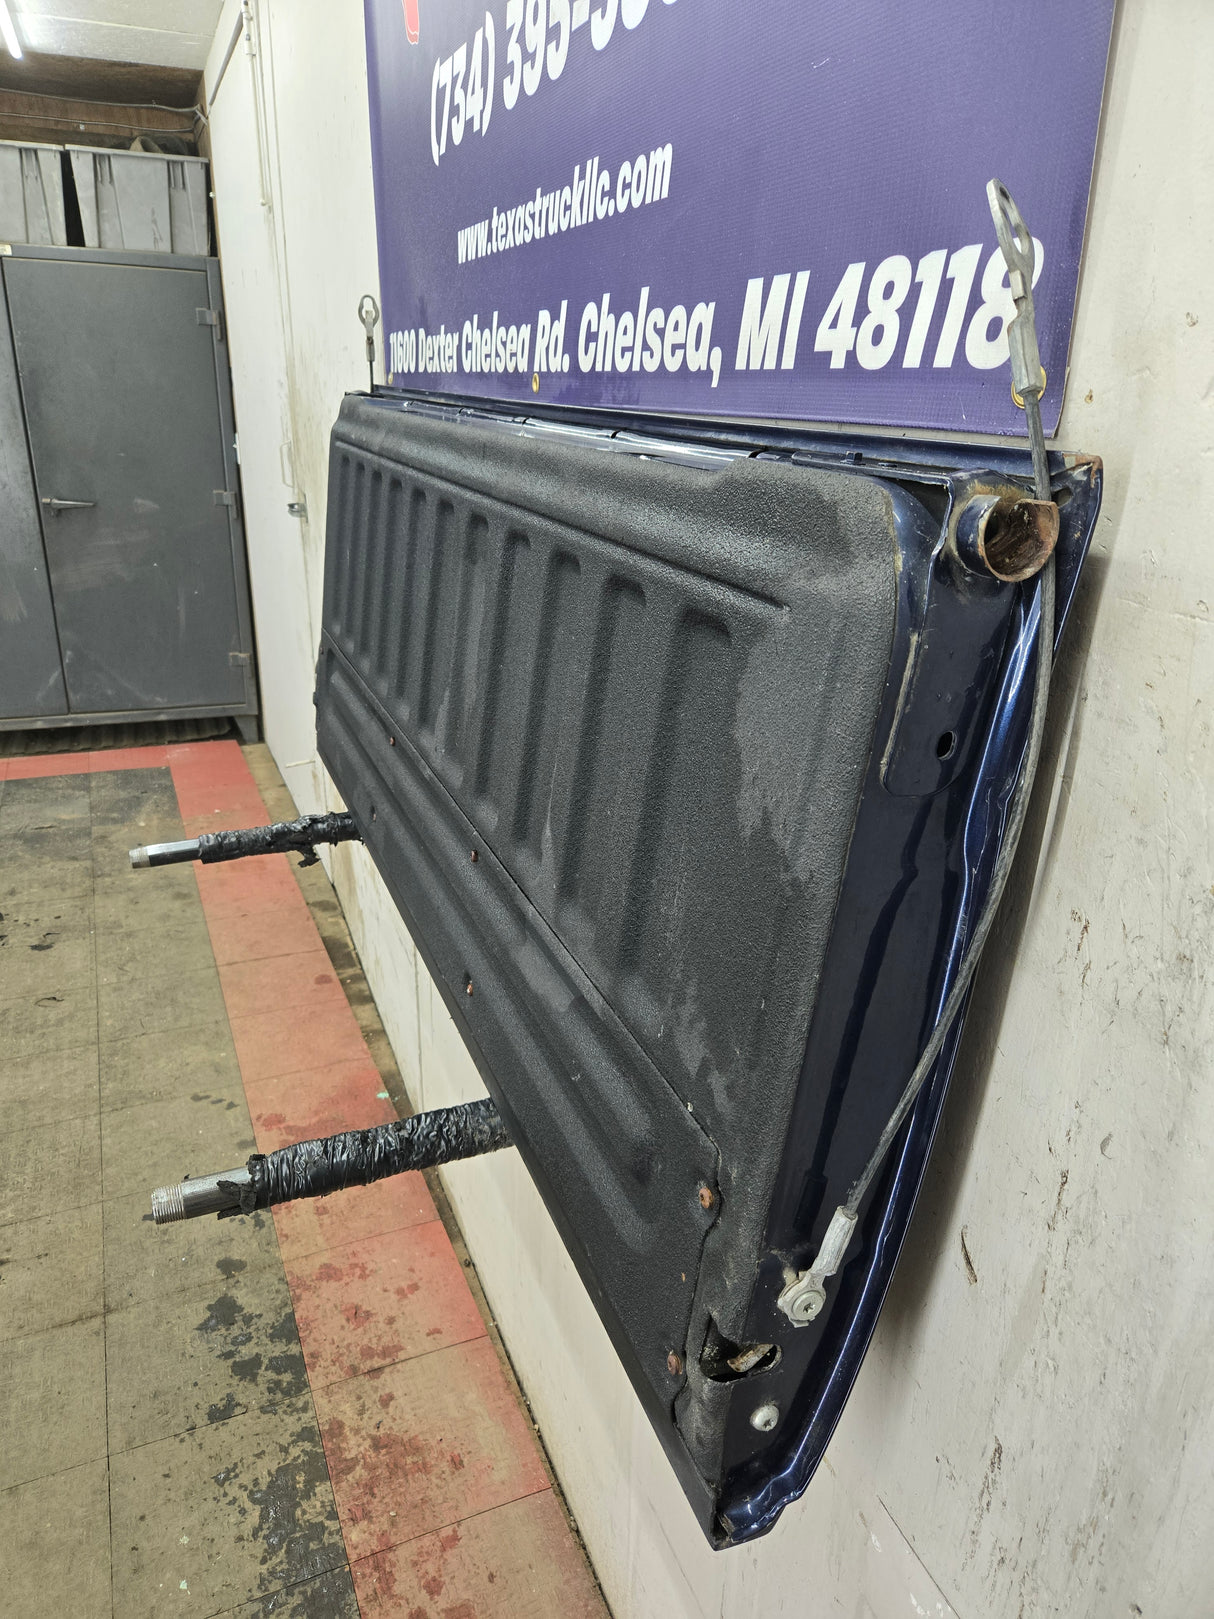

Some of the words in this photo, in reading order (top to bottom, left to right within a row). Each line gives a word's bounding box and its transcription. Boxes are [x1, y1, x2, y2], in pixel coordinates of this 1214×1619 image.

[431, 11, 495, 166] (734)
[458, 143, 673, 264] www.texastruckllc.com
[389, 328, 417, 373] 11600
[418, 324, 459, 373] Dexter
[461, 311, 531, 373] Chelsea
[533, 300, 570, 373] Rd.
[578, 286, 722, 388] Chelsea,
[735, 270, 811, 370] MI
[814, 237, 1045, 370] 48118
